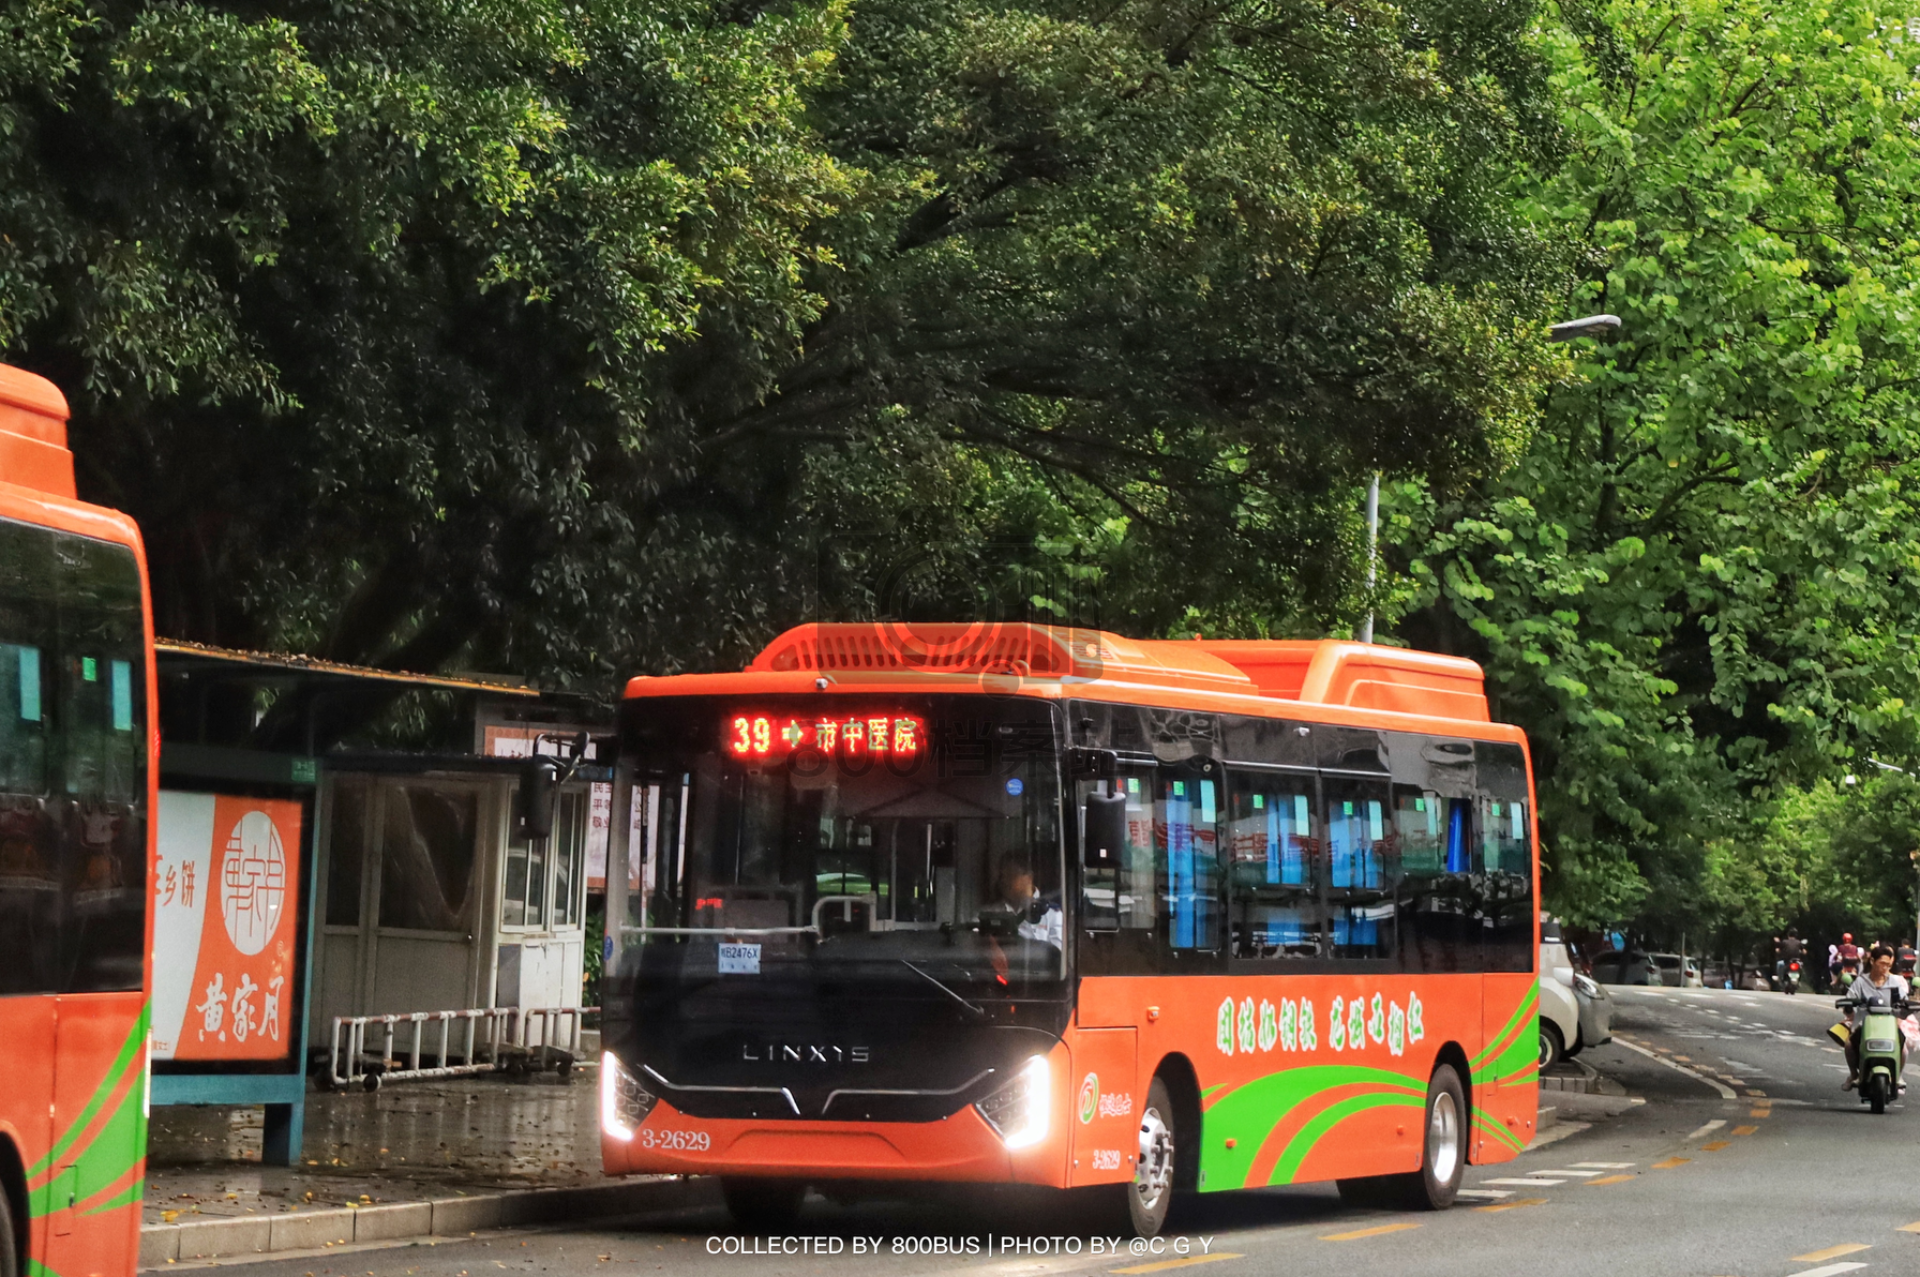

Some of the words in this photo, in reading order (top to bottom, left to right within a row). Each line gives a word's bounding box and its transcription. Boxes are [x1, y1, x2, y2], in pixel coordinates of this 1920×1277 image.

[734, 717, 771, 752] 39
[815, 717, 917, 752] 市中医院
[196, 972, 284, 1042] 黄家月
[642, 1129, 711, 1151] 3-2629
